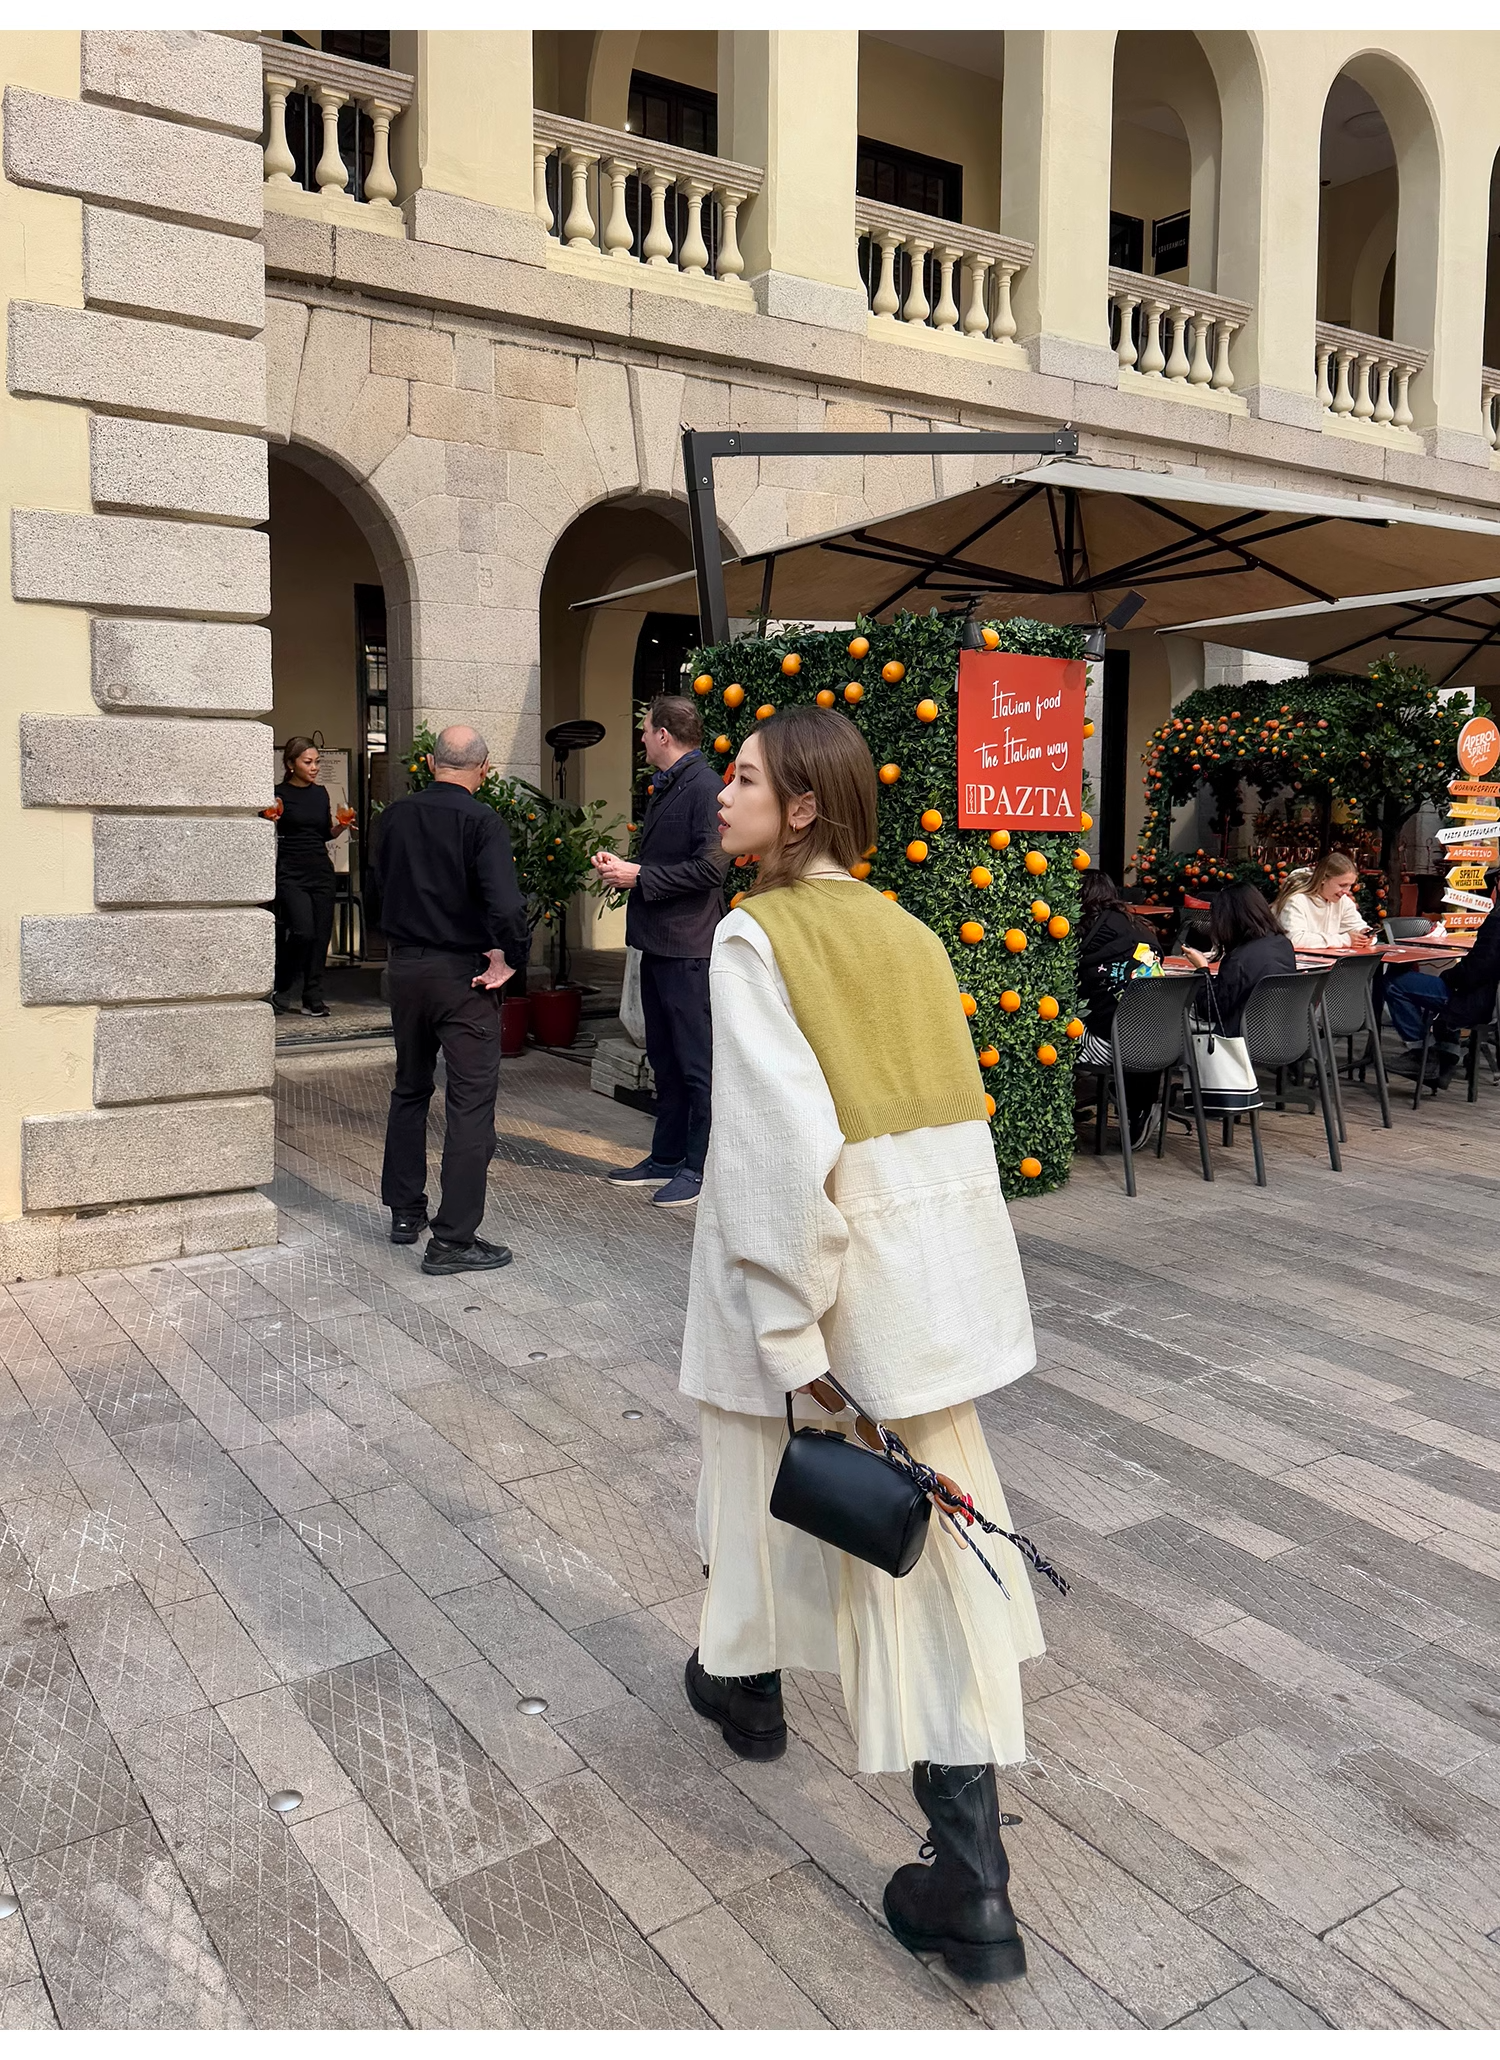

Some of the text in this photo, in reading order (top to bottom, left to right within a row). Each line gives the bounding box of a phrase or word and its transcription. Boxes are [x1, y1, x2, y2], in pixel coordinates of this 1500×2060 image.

[991, 680, 1062, 720] Italian food
[1462, 730, 1496, 752] APEROL
[1003, 727, 1042, 765] Italian
[1047, 741, 1068, 772] way
[1467, 742, 1491, 758] SPRITZ
[978, 785, 1075, 818] PAZTA
[1463, 826, 1498, 837] RESTAURANT
[1453, 850, 1492, 858] APERITIVO
[1460, 869, 1480, 879] SPRITZ
[1450, 917, 1462, 925] ICE
